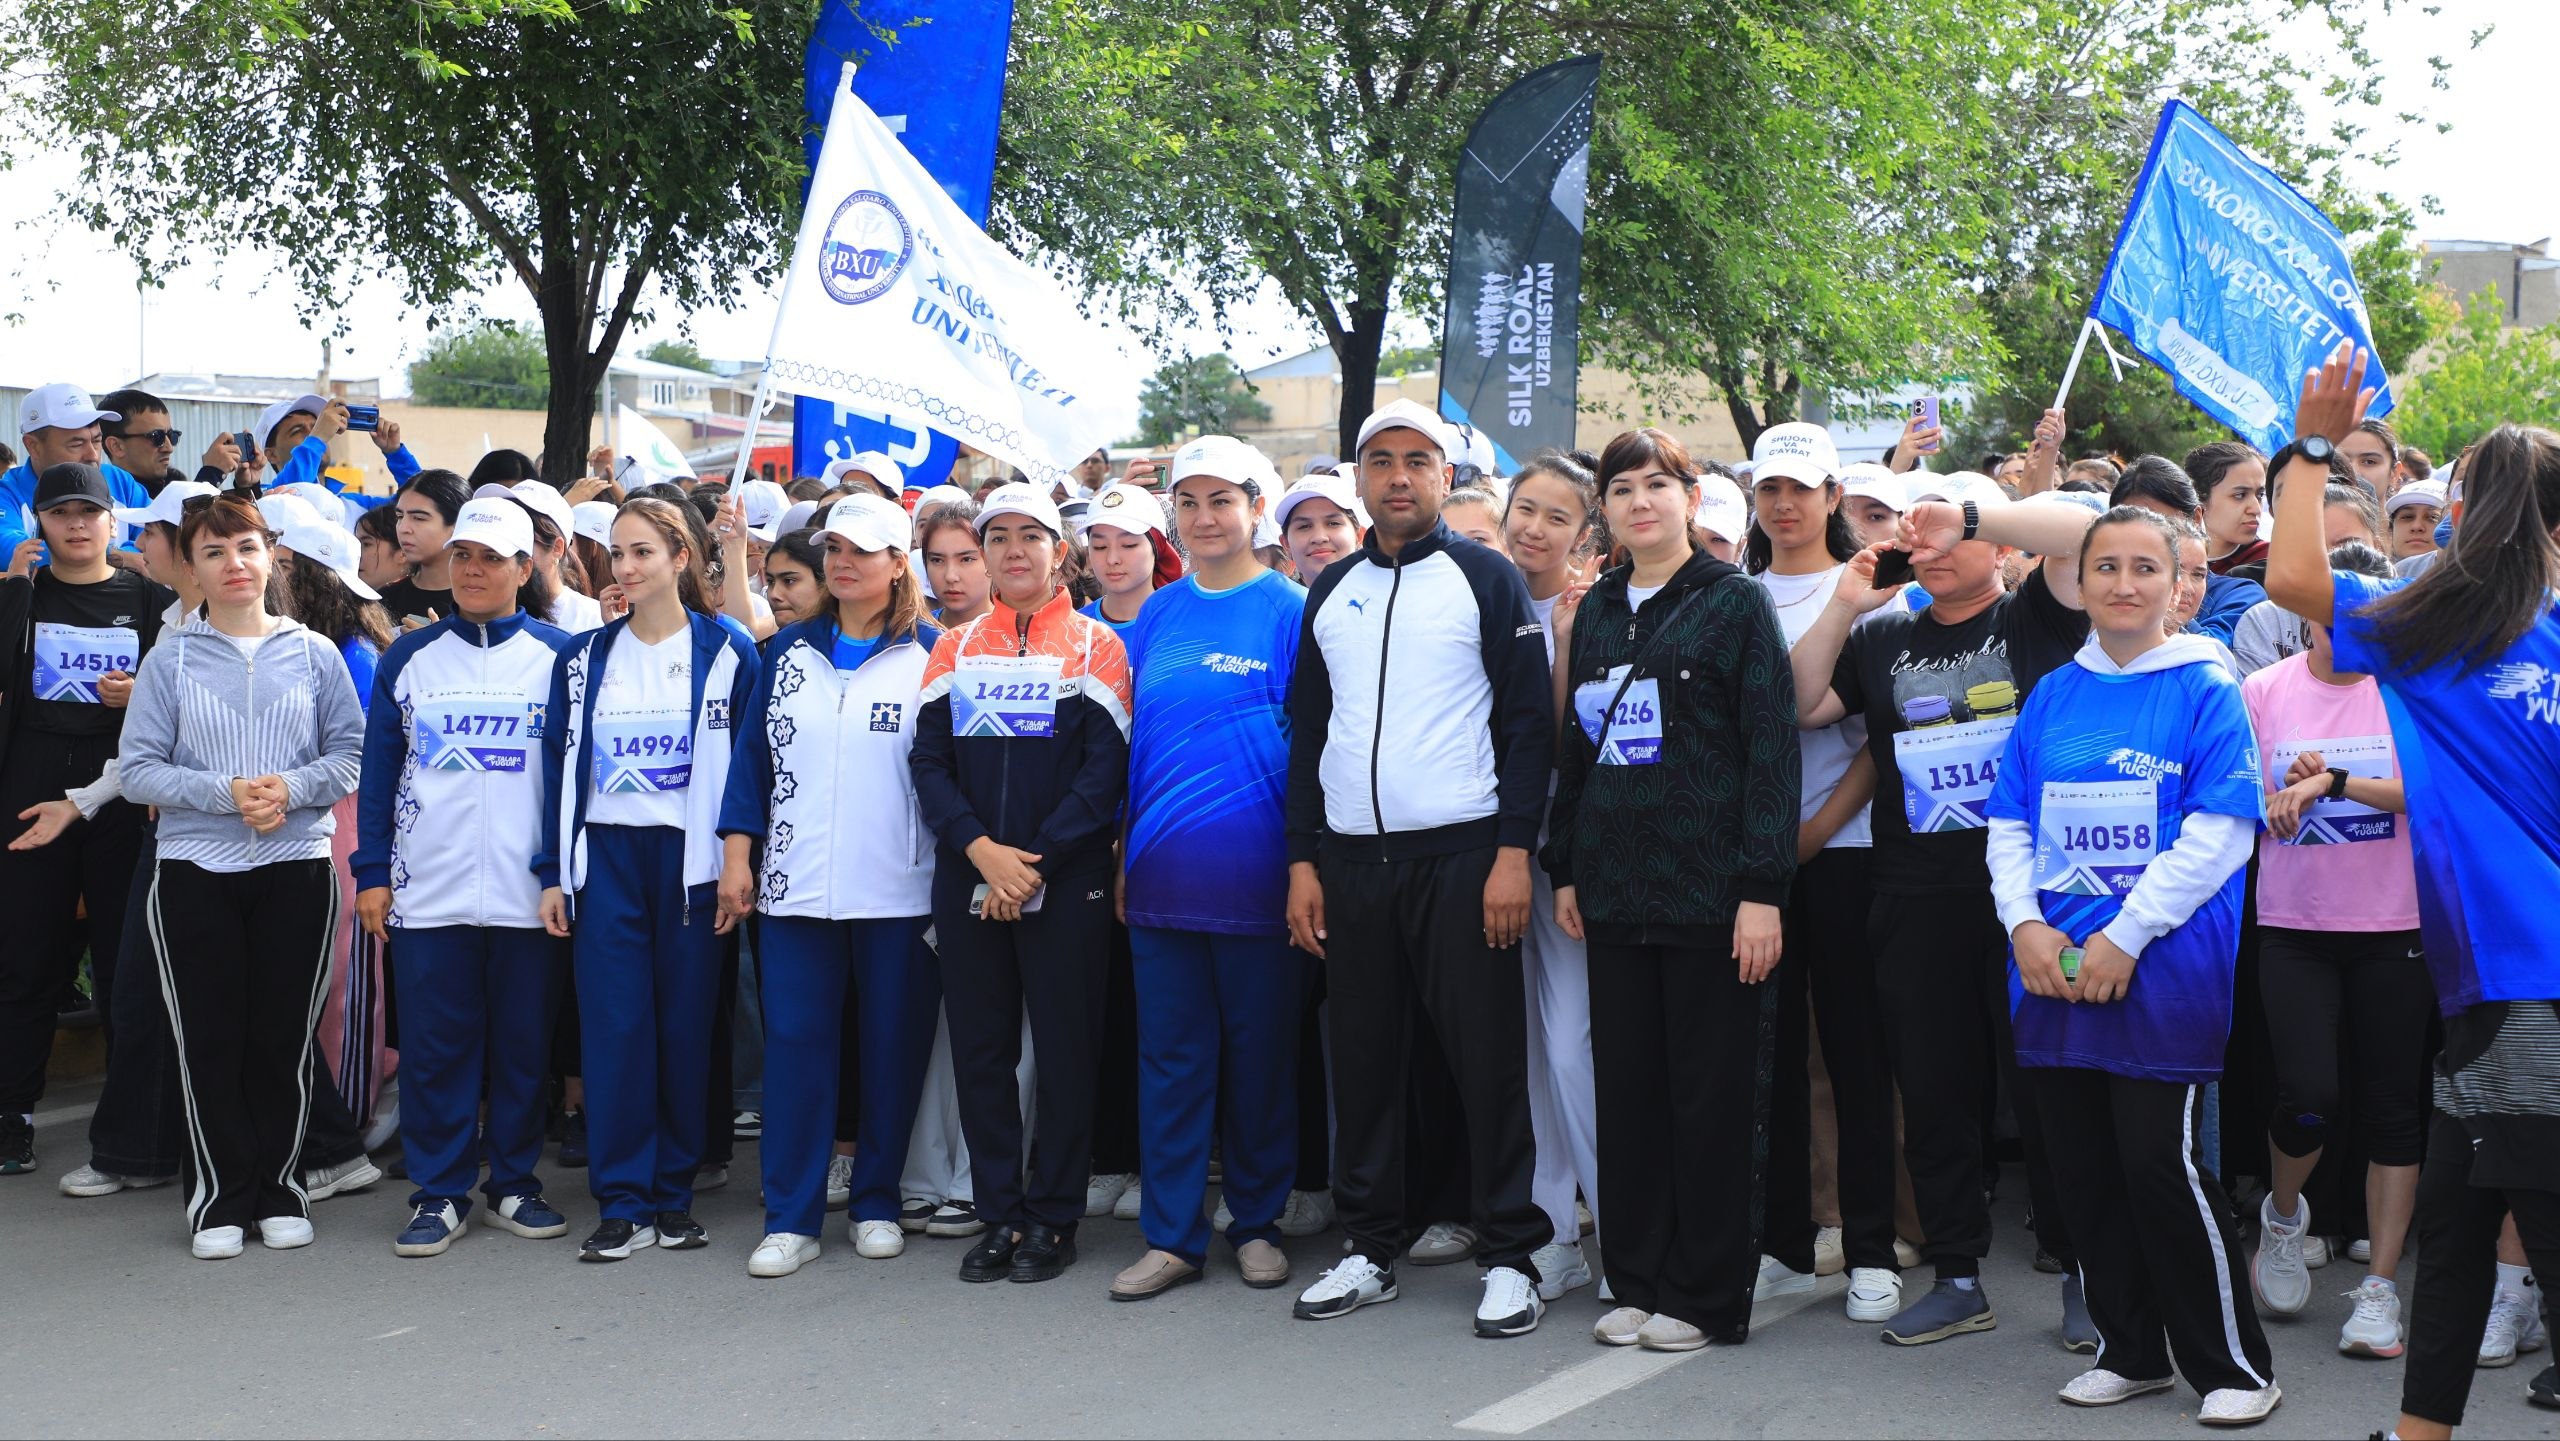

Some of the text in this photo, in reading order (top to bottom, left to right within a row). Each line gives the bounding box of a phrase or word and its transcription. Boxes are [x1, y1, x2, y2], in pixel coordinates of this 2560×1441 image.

[2177, 159, 2279, 245] BUXORO
[834, 250, 880, 276] BXU
[1536, 262, 1555, 387] UZBEKISTAN
[1508, 363, 1532, 427] SILK
[1771, 435, 1813, 444] SHIJOAT
[59, 651, 131, 672] 14519
[1210, 663, 1250, 677] YUGUR
[1224, 655, 1268, 673] TALABA
[974, 682, 1050, 701] 14222
[953, 705, 961, 721] km
[443, 714, 520, 737] 14777
[872, 722, 897, 731] 2021
[420, 739, 429, 755] km
[612, 735, 690, 757] 14994
[497, 755, 521, 763] TALABA
[2133, 752, 2183, 776] TALABA
[1929, 757, 2001, 791] 1314
[2118, 761, 2164, 784] YUGUR
[1908, 798, 1917, 816] km
[2354, 825, 2384, 837] YUGUR
[2363, 820, 2390, 829] TALABA
[2064, 824, 2151, 851] 14058
[2036, 844, 2051, 873] 3 km
